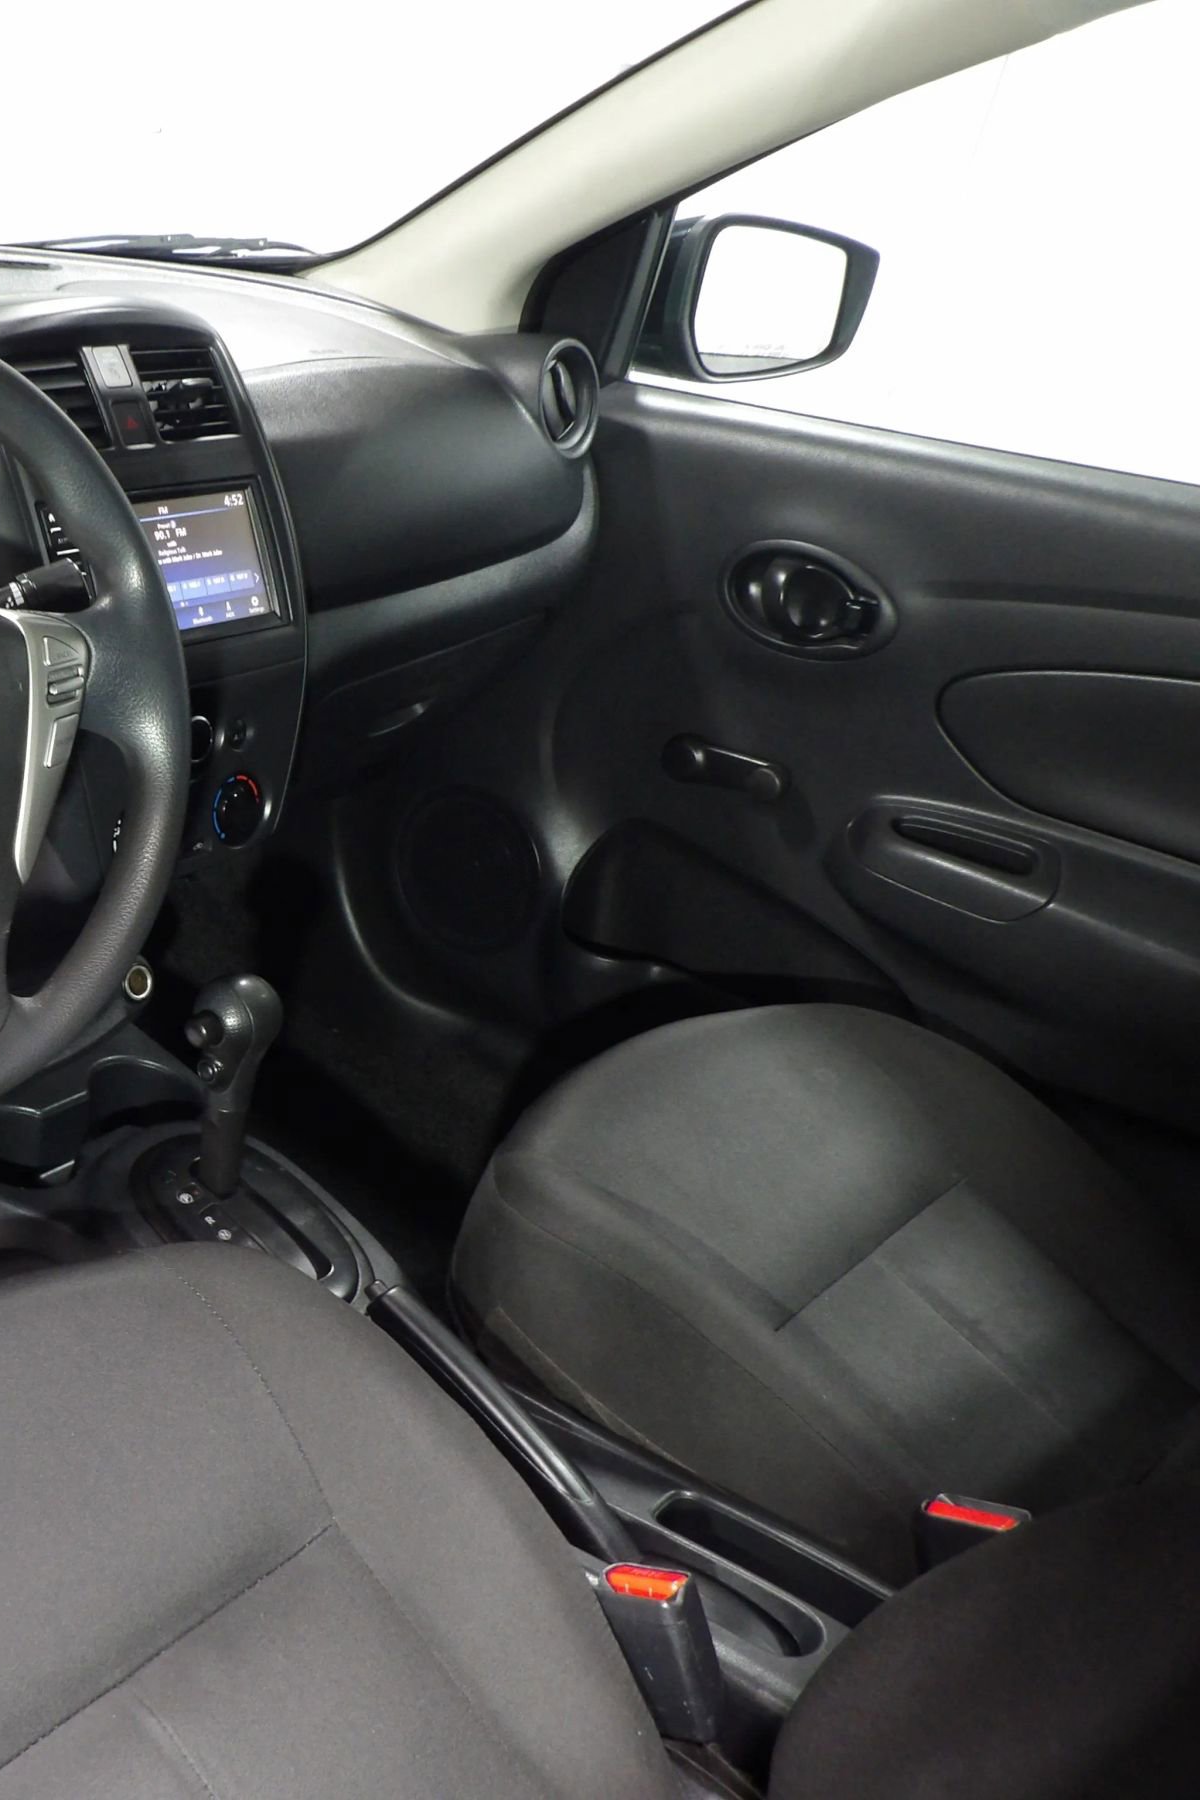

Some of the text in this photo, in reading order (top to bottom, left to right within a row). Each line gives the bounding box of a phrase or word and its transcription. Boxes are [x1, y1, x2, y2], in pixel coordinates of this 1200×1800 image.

[224, 493, 244, 507] 4:52
[157, 506, 168, 515] FM
[154, 527, 187, 541] 90.1 FM
